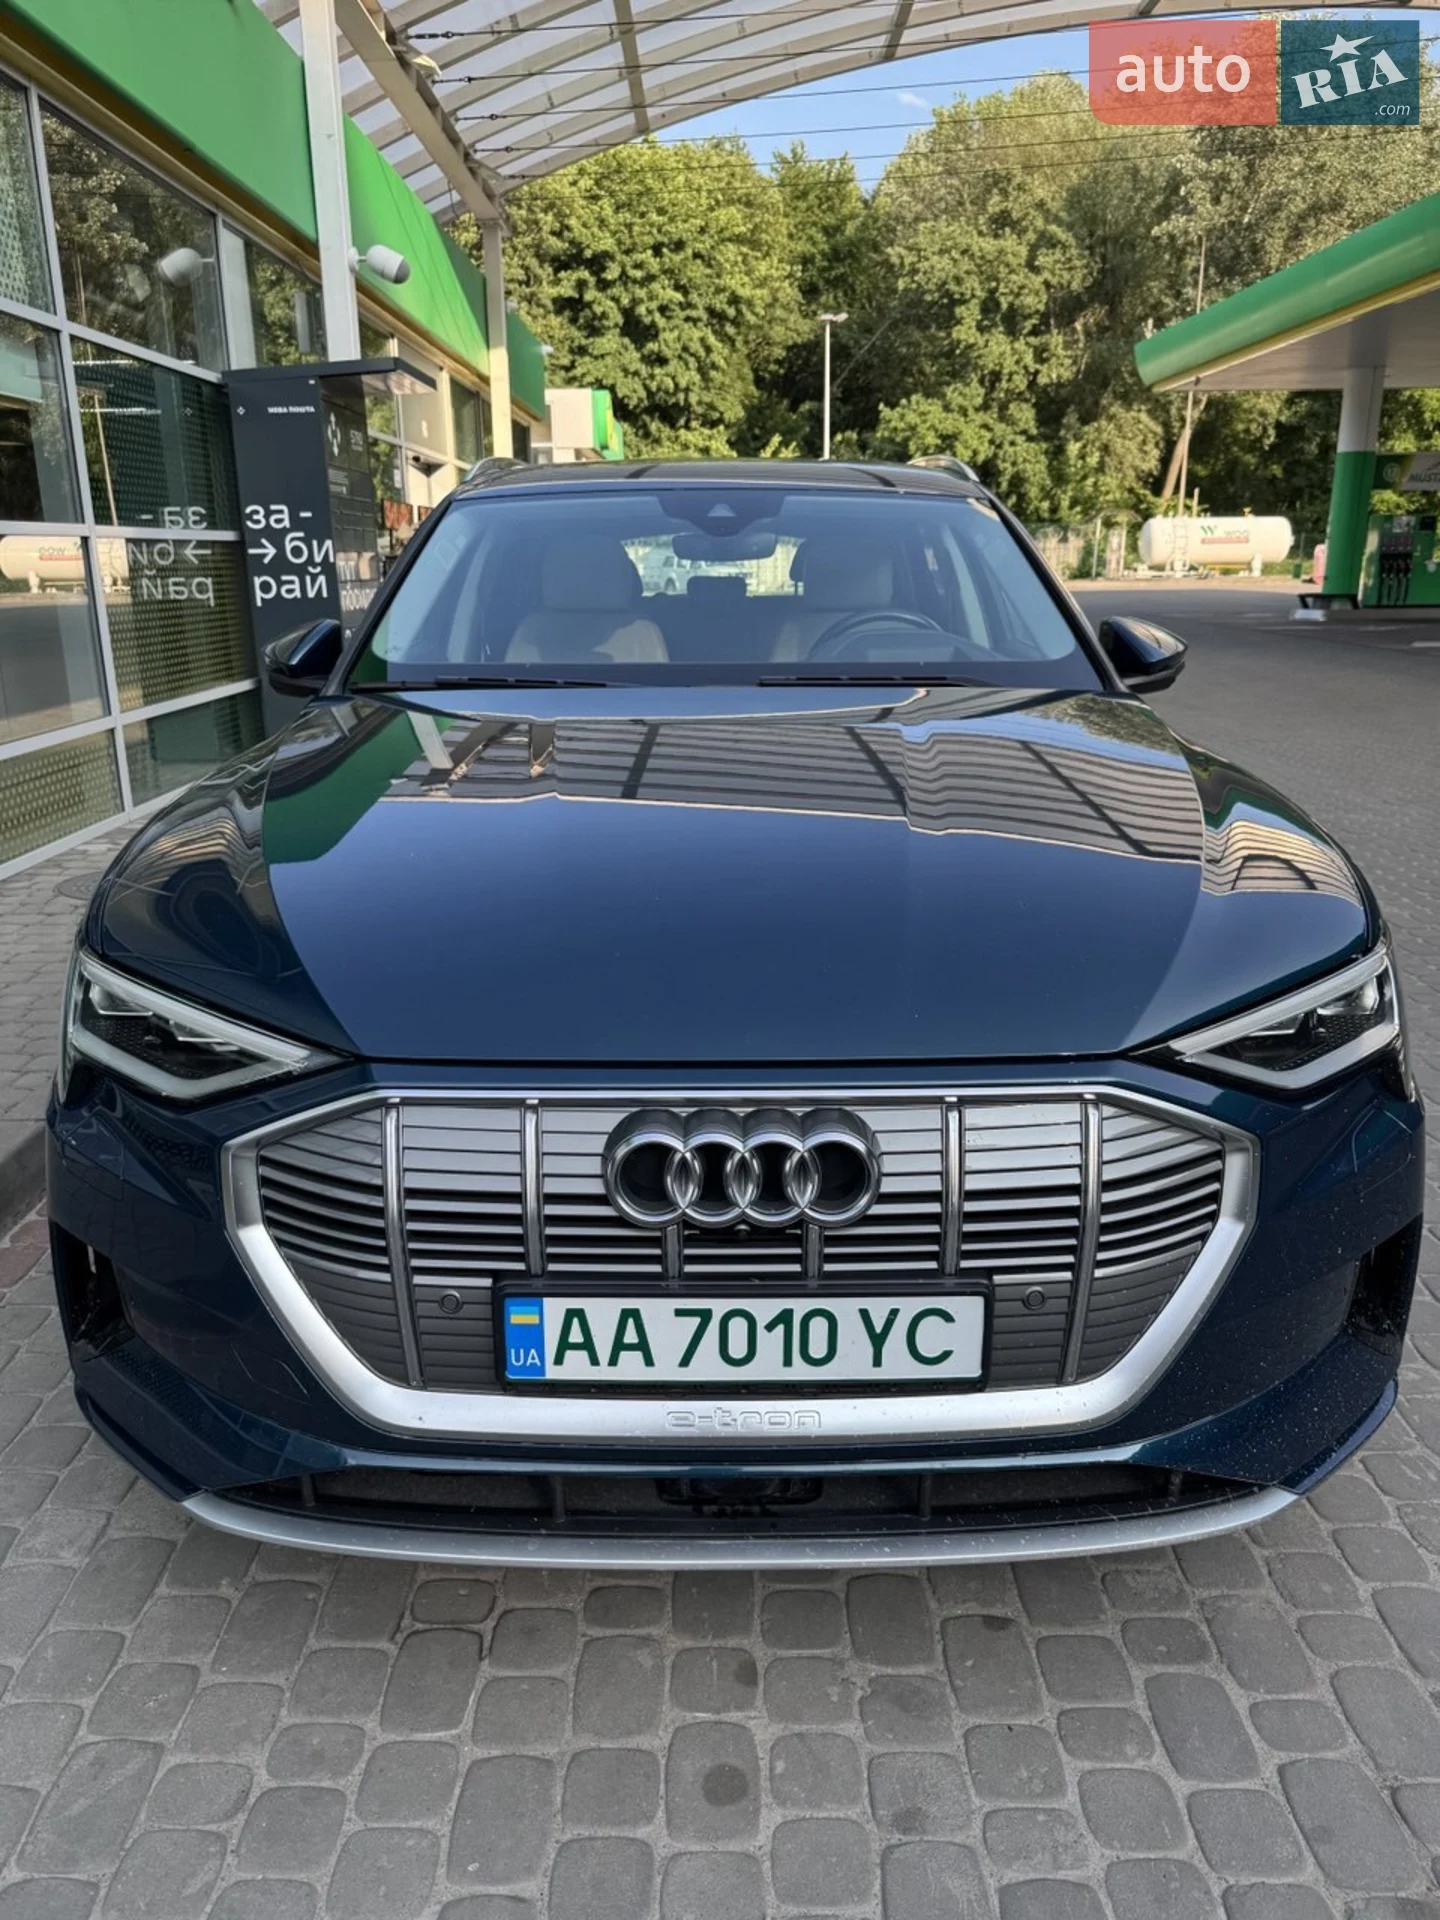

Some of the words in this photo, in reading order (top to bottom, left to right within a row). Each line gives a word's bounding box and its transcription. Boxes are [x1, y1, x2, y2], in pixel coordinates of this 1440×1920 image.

[284, 531, 335, 564] би
[253, 566, 329, 607] рай
[553, 1307, 655, 1367] AA
[674, 1307, 838, 1367] 7010
[858, 1307, 955, 1367] YC
[511, 1349, 541, 1367] UA
[665, 1406, 822, 1431] e-tron
